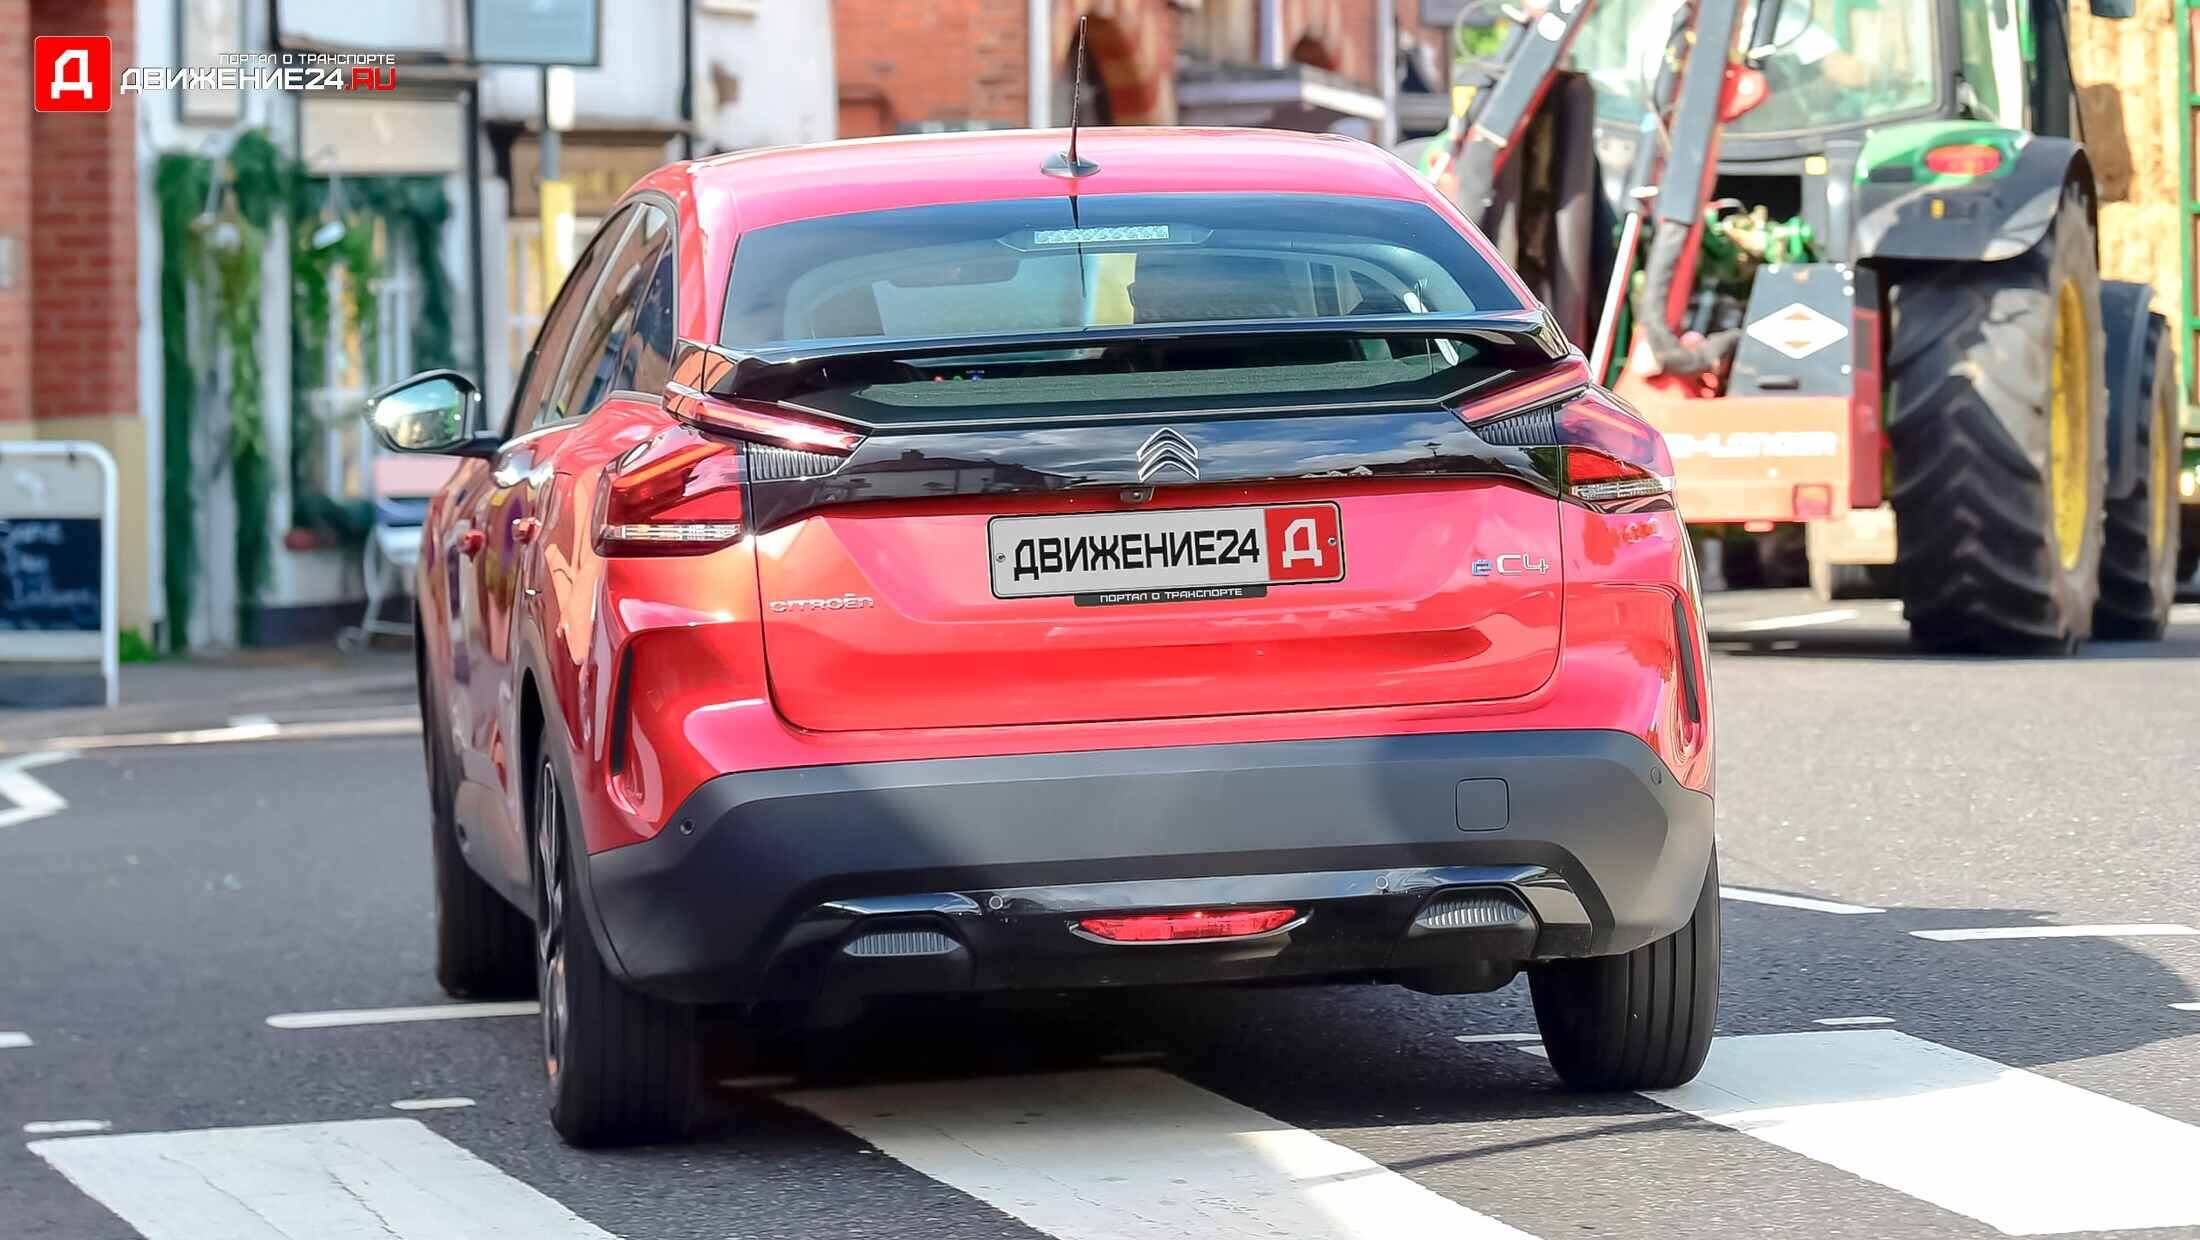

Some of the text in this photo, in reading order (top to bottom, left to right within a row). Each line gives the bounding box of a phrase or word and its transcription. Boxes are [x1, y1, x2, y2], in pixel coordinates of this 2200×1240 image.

[1014, 518, 1323, 581] ДВИЖЕНИЕ24 Д
[1100, 593, 1148, 603] ПОРТАЛ
[1165, 588, 1243, 600] ТРАНСПОРТЕ
